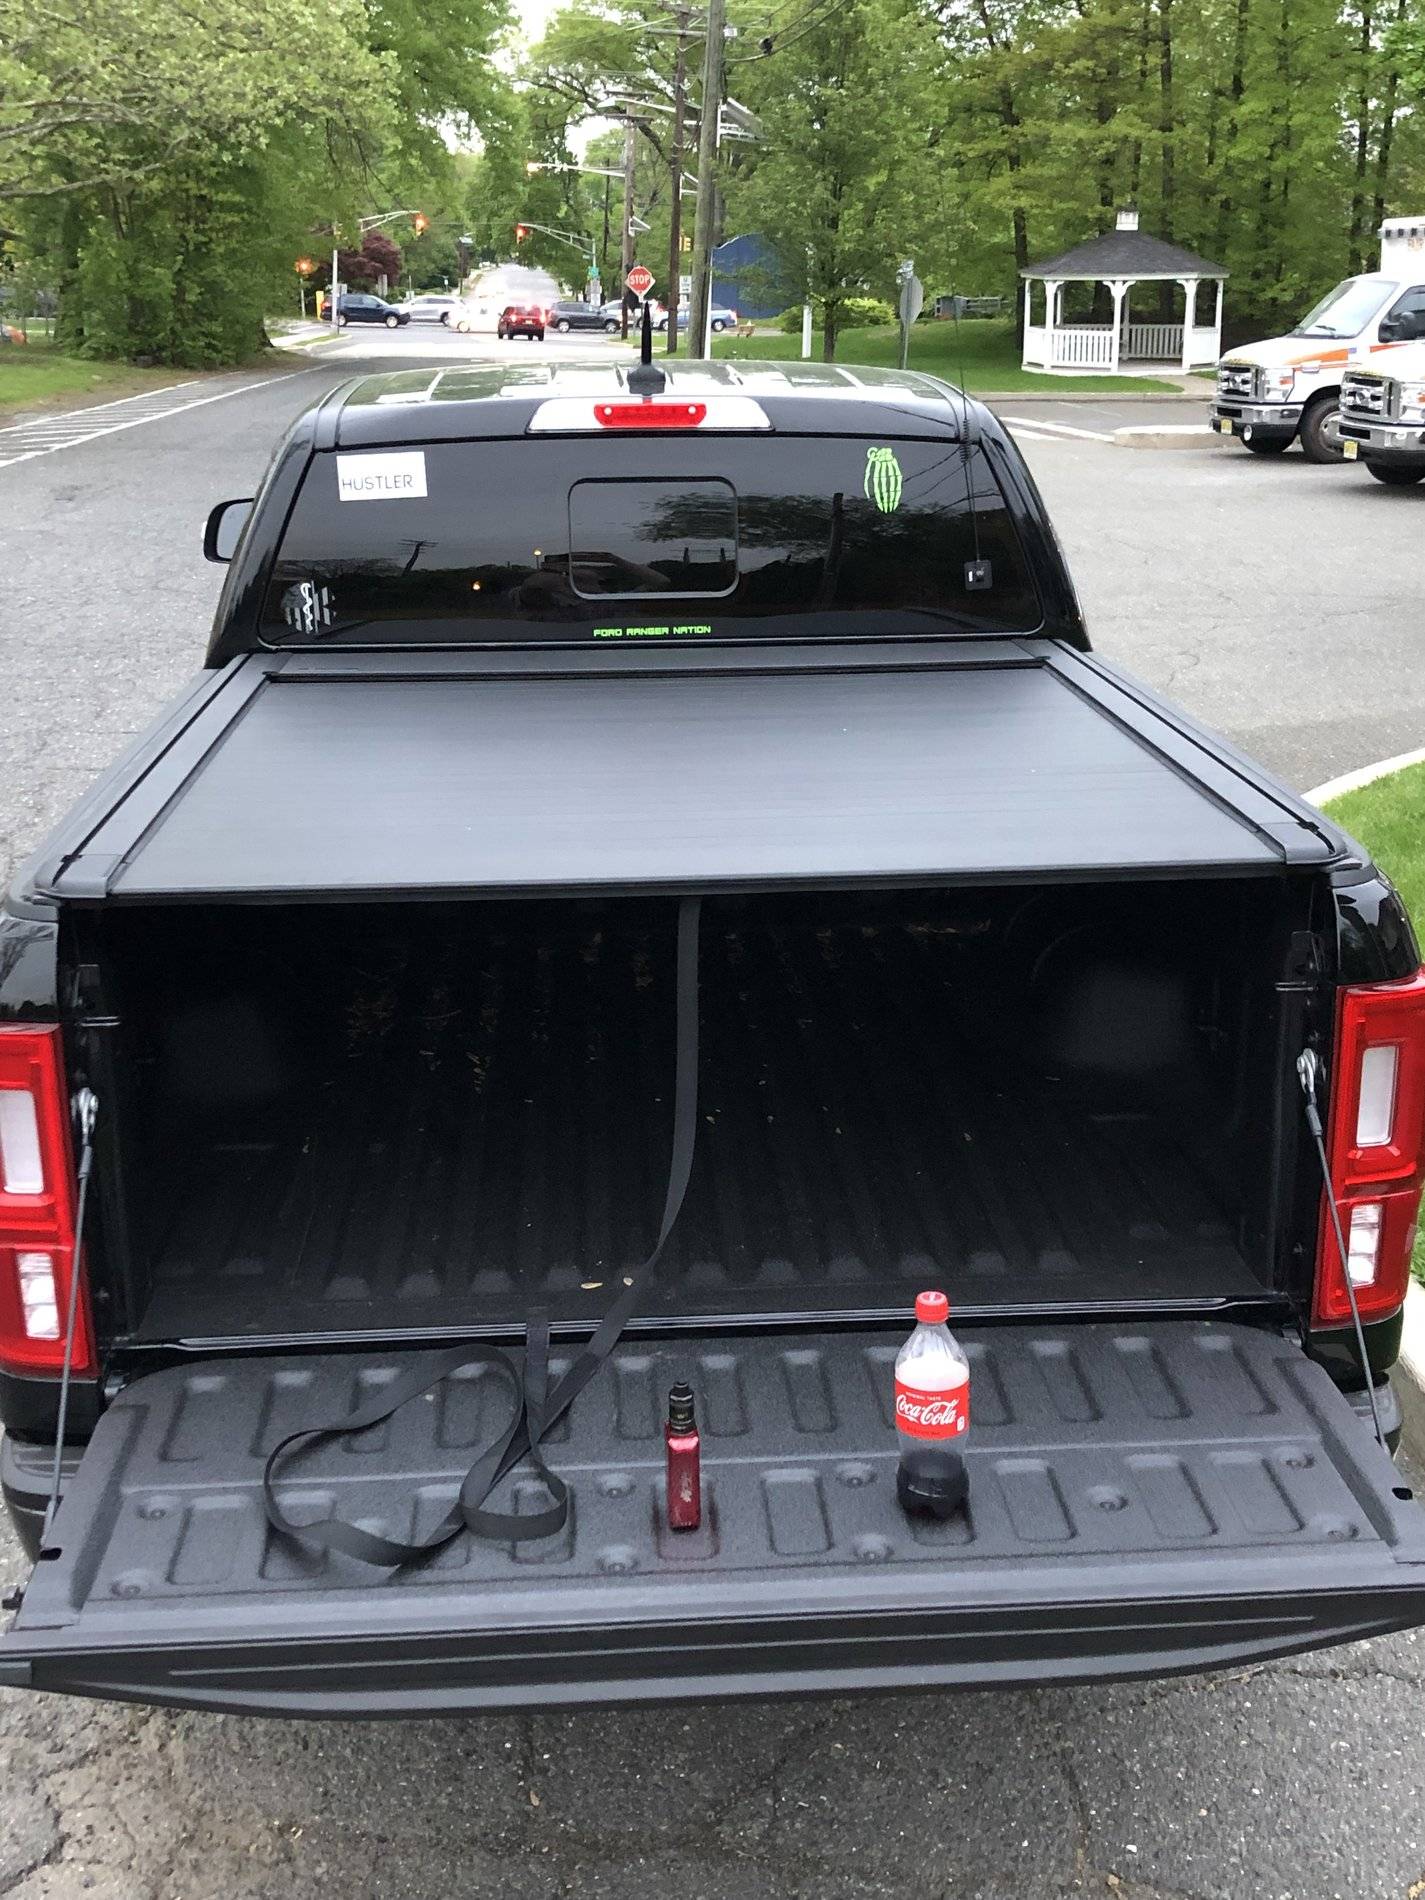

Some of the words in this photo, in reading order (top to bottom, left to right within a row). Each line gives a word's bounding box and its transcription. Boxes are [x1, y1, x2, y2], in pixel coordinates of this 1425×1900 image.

[630, 274, 650, 285] STOP
[342, 474, 414, 491] HUSTLER
[593, 629, 622, 637] FORD
[626, 627, 669, 636] RANGER
[673, 626, 711, 634] NATION
[896, 1394, 959, 1425] Coca-Cola
